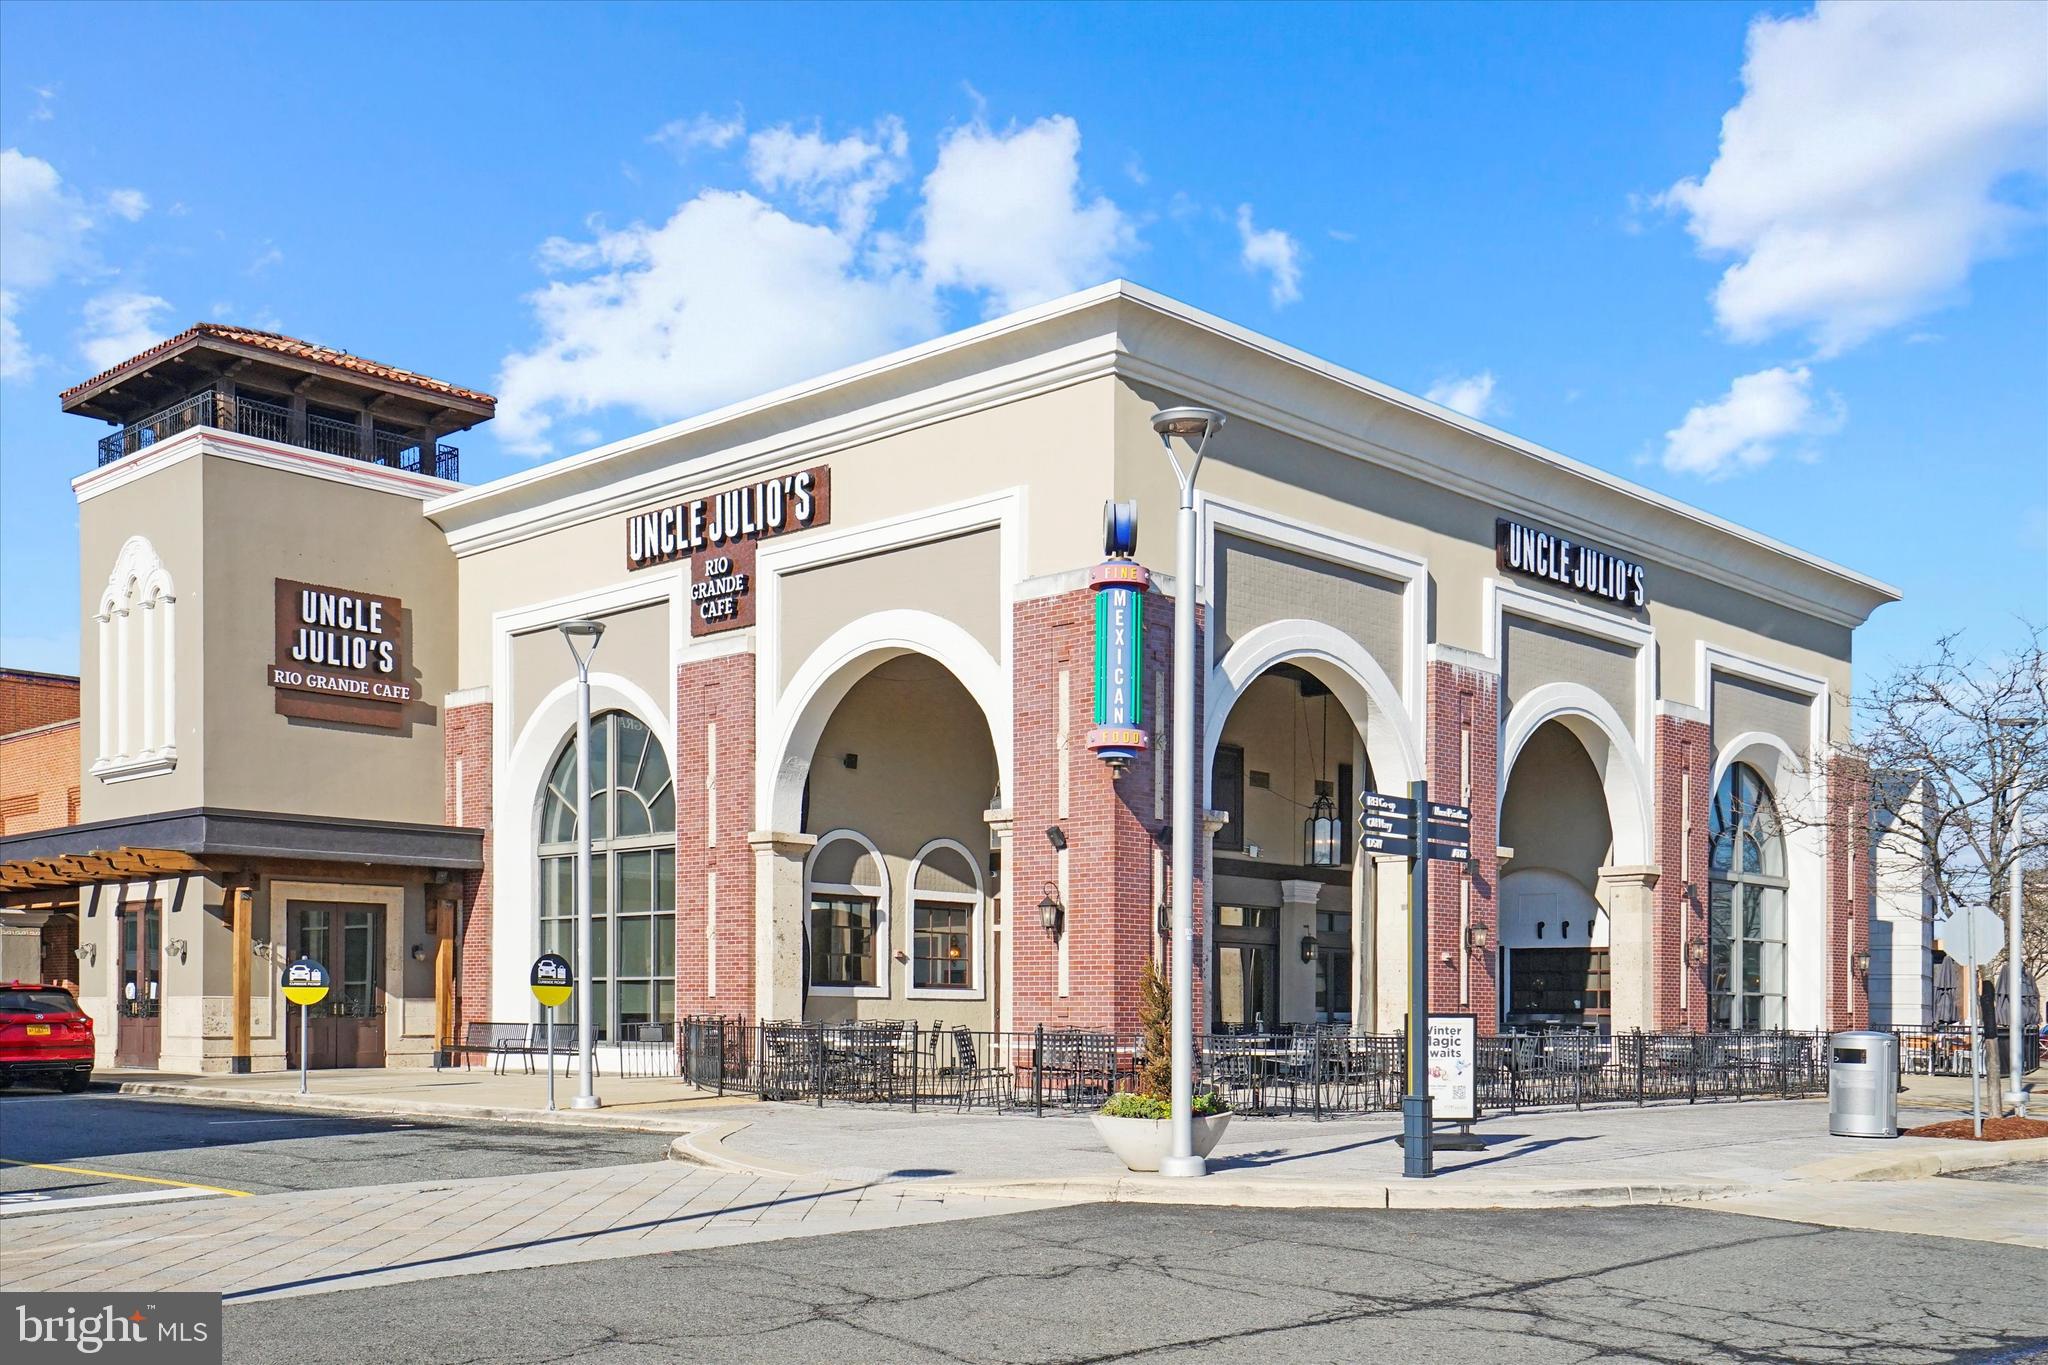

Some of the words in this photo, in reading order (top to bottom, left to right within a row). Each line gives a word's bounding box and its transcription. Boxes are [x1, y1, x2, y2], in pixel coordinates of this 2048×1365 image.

[630, 499, 702, 561] UNCLE
[708, 471, 810, 542] JULIO'S
[704, 556, 728, 577] RIO
[1104, 566, 1137, 580] FINE
[1510, 522, 1570, 584] UNCLE
[1574, 546, 1644, 607] JULIO'S
[691, 573, 744, 600] GRANDE
[302, 590, 382, 634] UNCLE
[700, 597, 733, 619] CAFE
[292, 628, 393, 673] JULIO'S
[1113, 590, 1126, 724] MEXICAN
[274, 669, 302, 686] RIO
[306, 674, 369, 694] GRANDE
[373, 683, 410, 700] CAFE
[1102, 731, 1139, 744] FOOD
[1428, 1035, 1461, 1049] agic
[1428, 1048, 1461, 1058] waits
